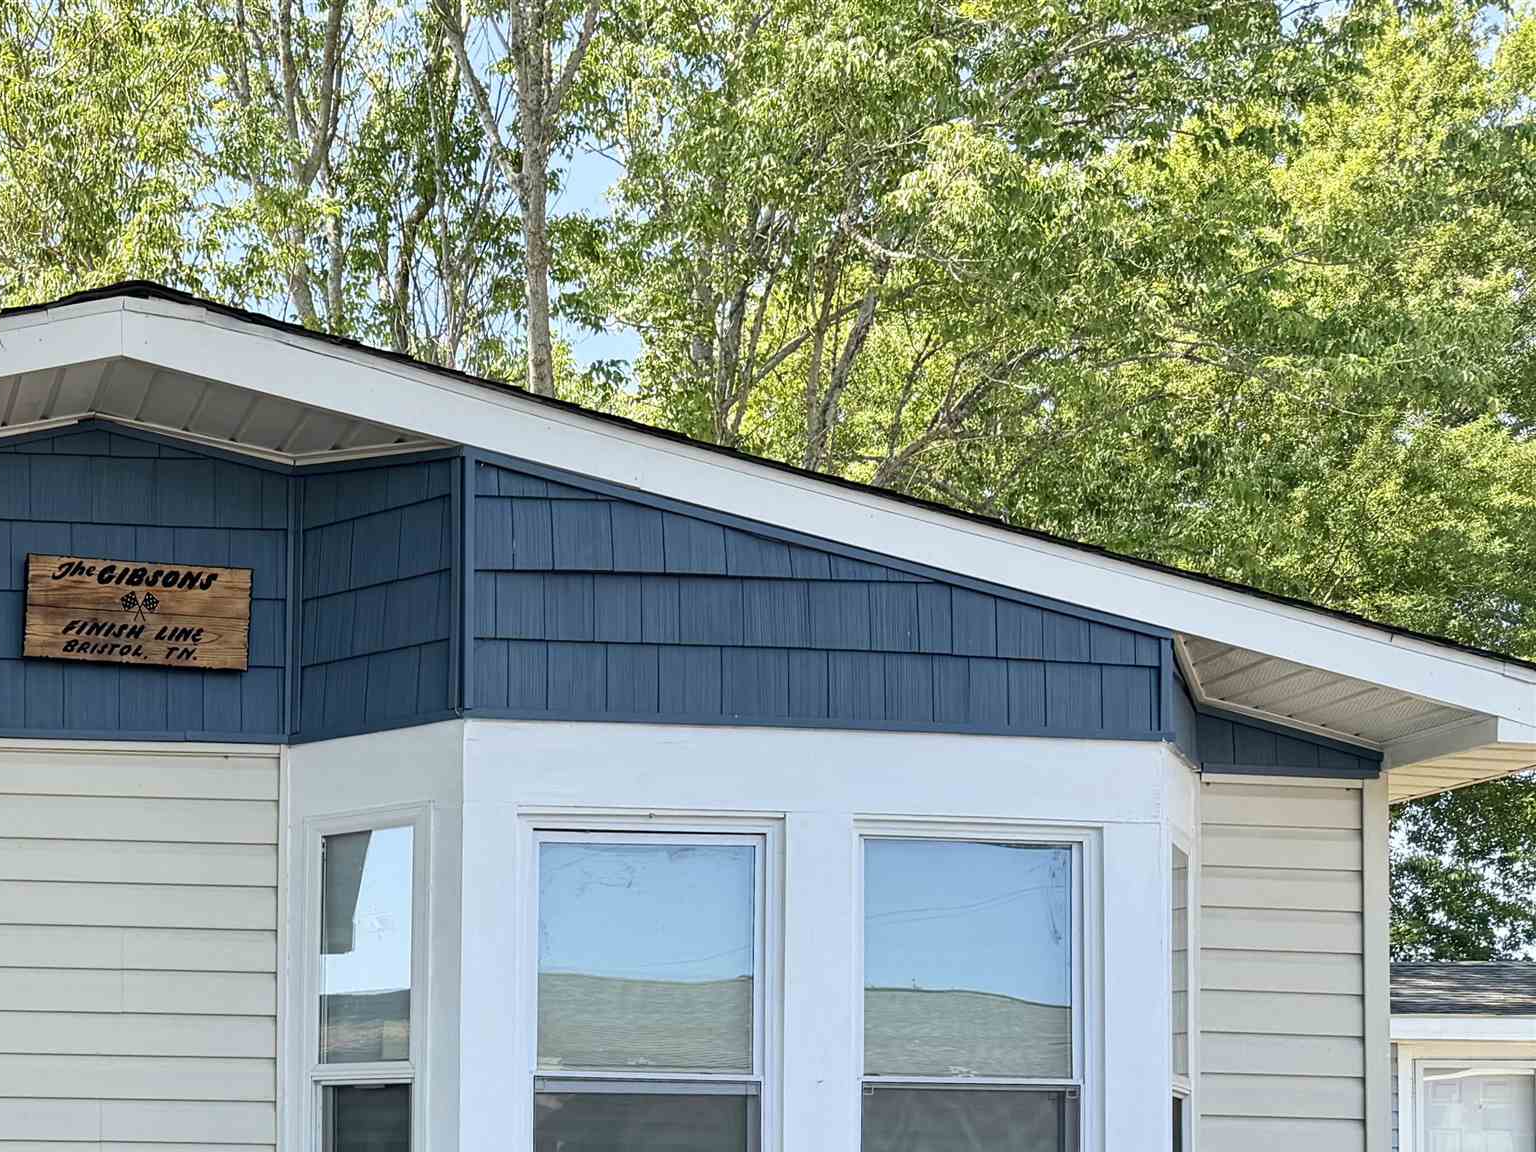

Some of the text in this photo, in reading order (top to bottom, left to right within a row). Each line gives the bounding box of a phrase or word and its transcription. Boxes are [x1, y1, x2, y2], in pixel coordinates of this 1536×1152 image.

[52, 560, 219, 591] The GIBSONS
[62, 620, 205, 643] FINISH LINE
[62, 640, 199, 661] BRISTOL, TN.
